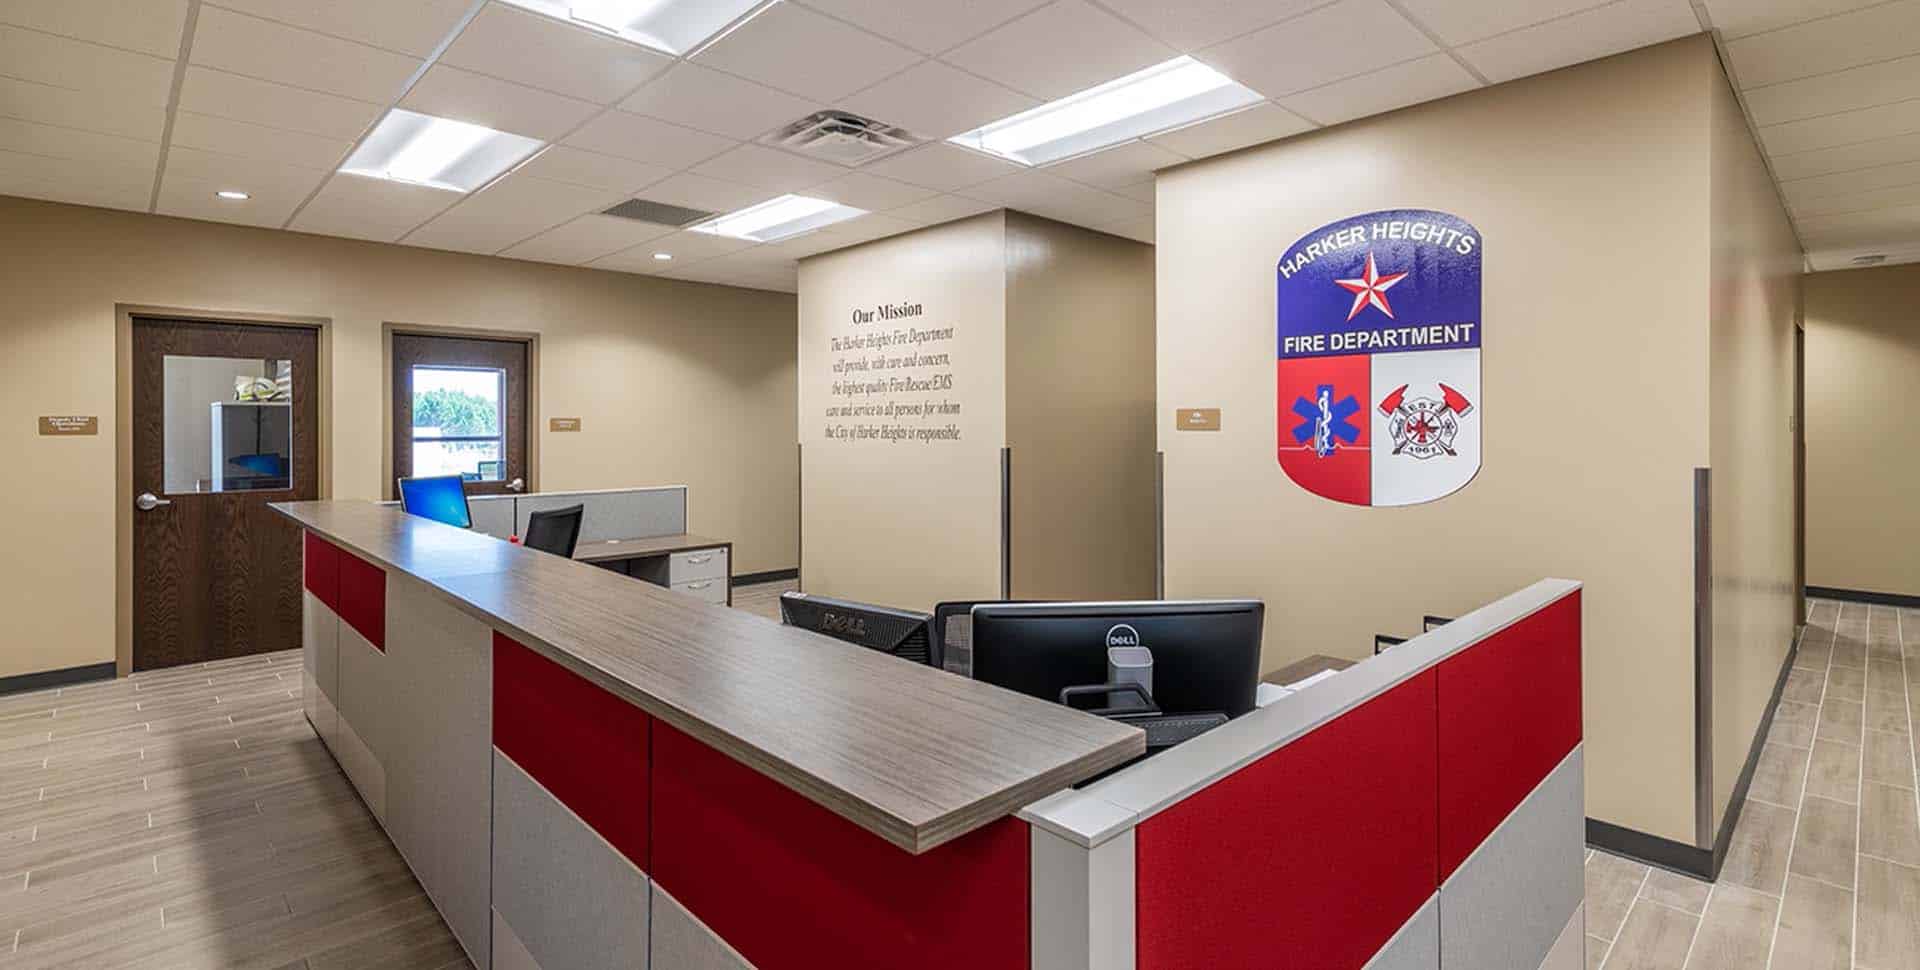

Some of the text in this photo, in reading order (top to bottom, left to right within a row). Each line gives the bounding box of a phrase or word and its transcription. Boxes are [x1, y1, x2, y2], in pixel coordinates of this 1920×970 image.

[1279, 221, 1476, 279] HARKER HEIGHTS
[852, 302, 923, 325] Our Mission
[843, 335, 865, 351] Harker
[866, 332, 892, 352] Heights
[892, 330, 908, 346] Fire
[909, 327, 954, 347] Department
[1284, 323, 1475, 354] FIRE DEPARTMENT
[886, 357, 902, 369] care
[902, 352, 918, 368] and
[842, 380, 865, 398] highest
[889, 376, 905, 393] Fire
[840, 402, 853, 417] and
[852, 403, 875, 417] service
[884, 400, 895, 416] all
[894, 404, 922, 420] persons
[921, 400, 935, 419] for
[937, 400, 960, 415] whom
[825, 424, 836, 439] the
[836, 424, 849, 442] City
[856, 424, 880, 440] Harker
[880, 424, 906, 444] Heights
[907, 425, 916, 440] is
[916, 423, 961, 444] responsible.
[823, 611, 865, 633] DELL
[1110, 636, 1135, 645] DELL
